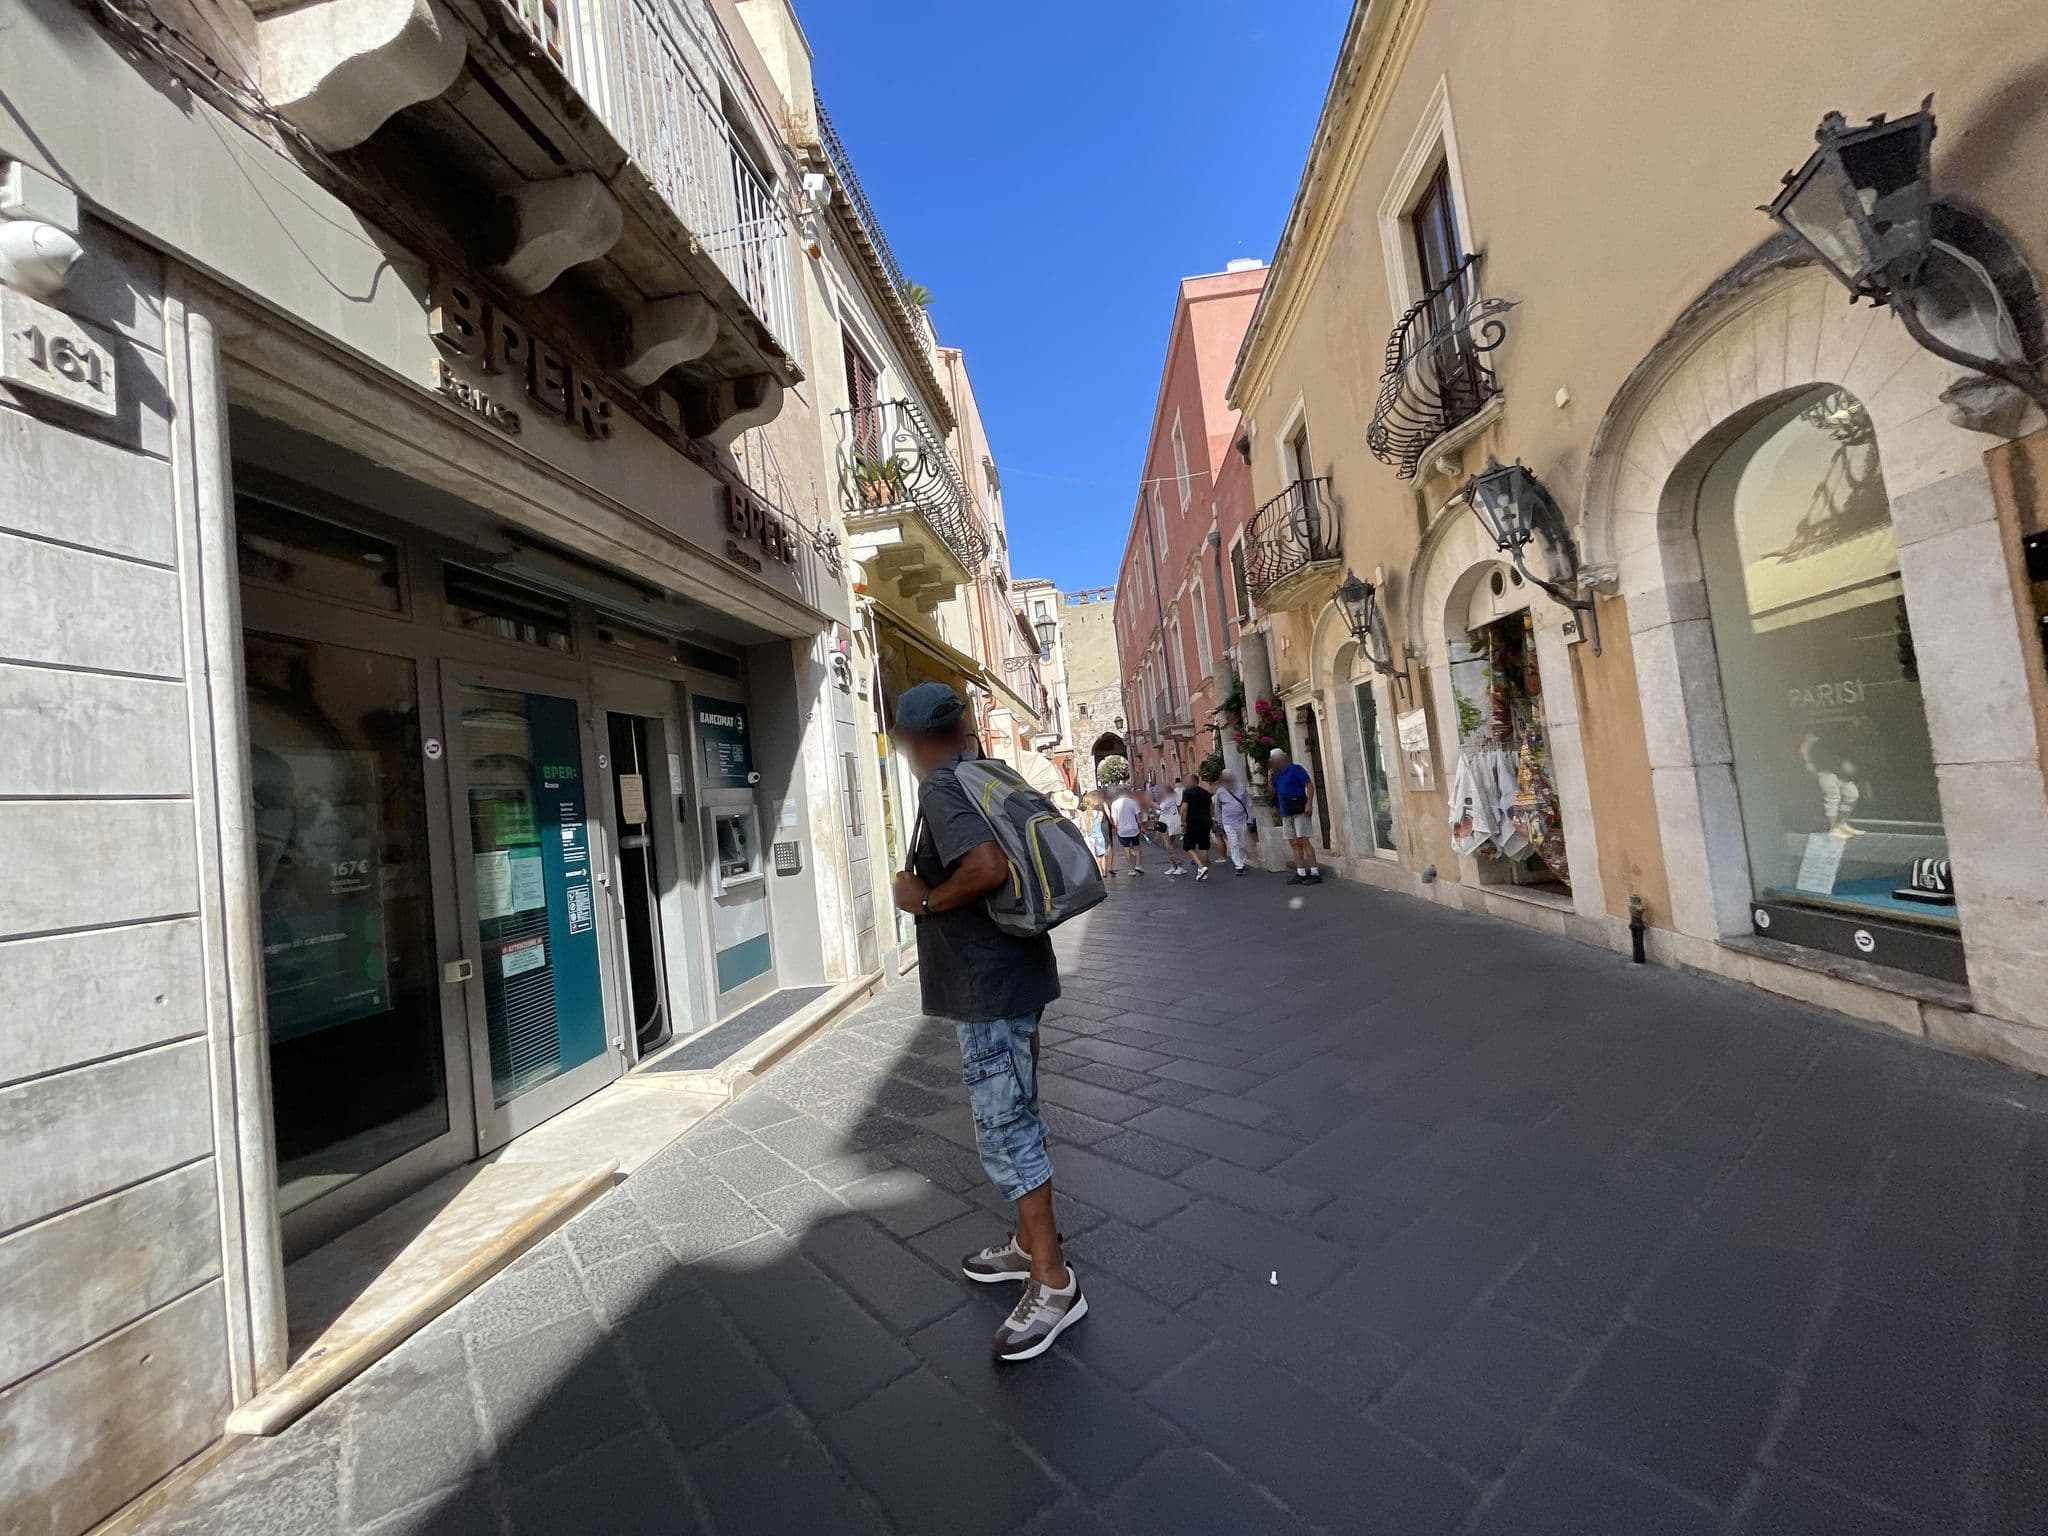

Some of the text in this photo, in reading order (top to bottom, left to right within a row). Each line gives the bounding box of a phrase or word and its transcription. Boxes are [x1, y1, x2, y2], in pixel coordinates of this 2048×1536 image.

[20, 323, 106, 394] 161
[431, 357, 522, 436] Banca
[1562, 620, 1576, 636] 168
[1788, 679, 1864, 706] PARISI
[699, 711, 734, 728] BANCOMAT
